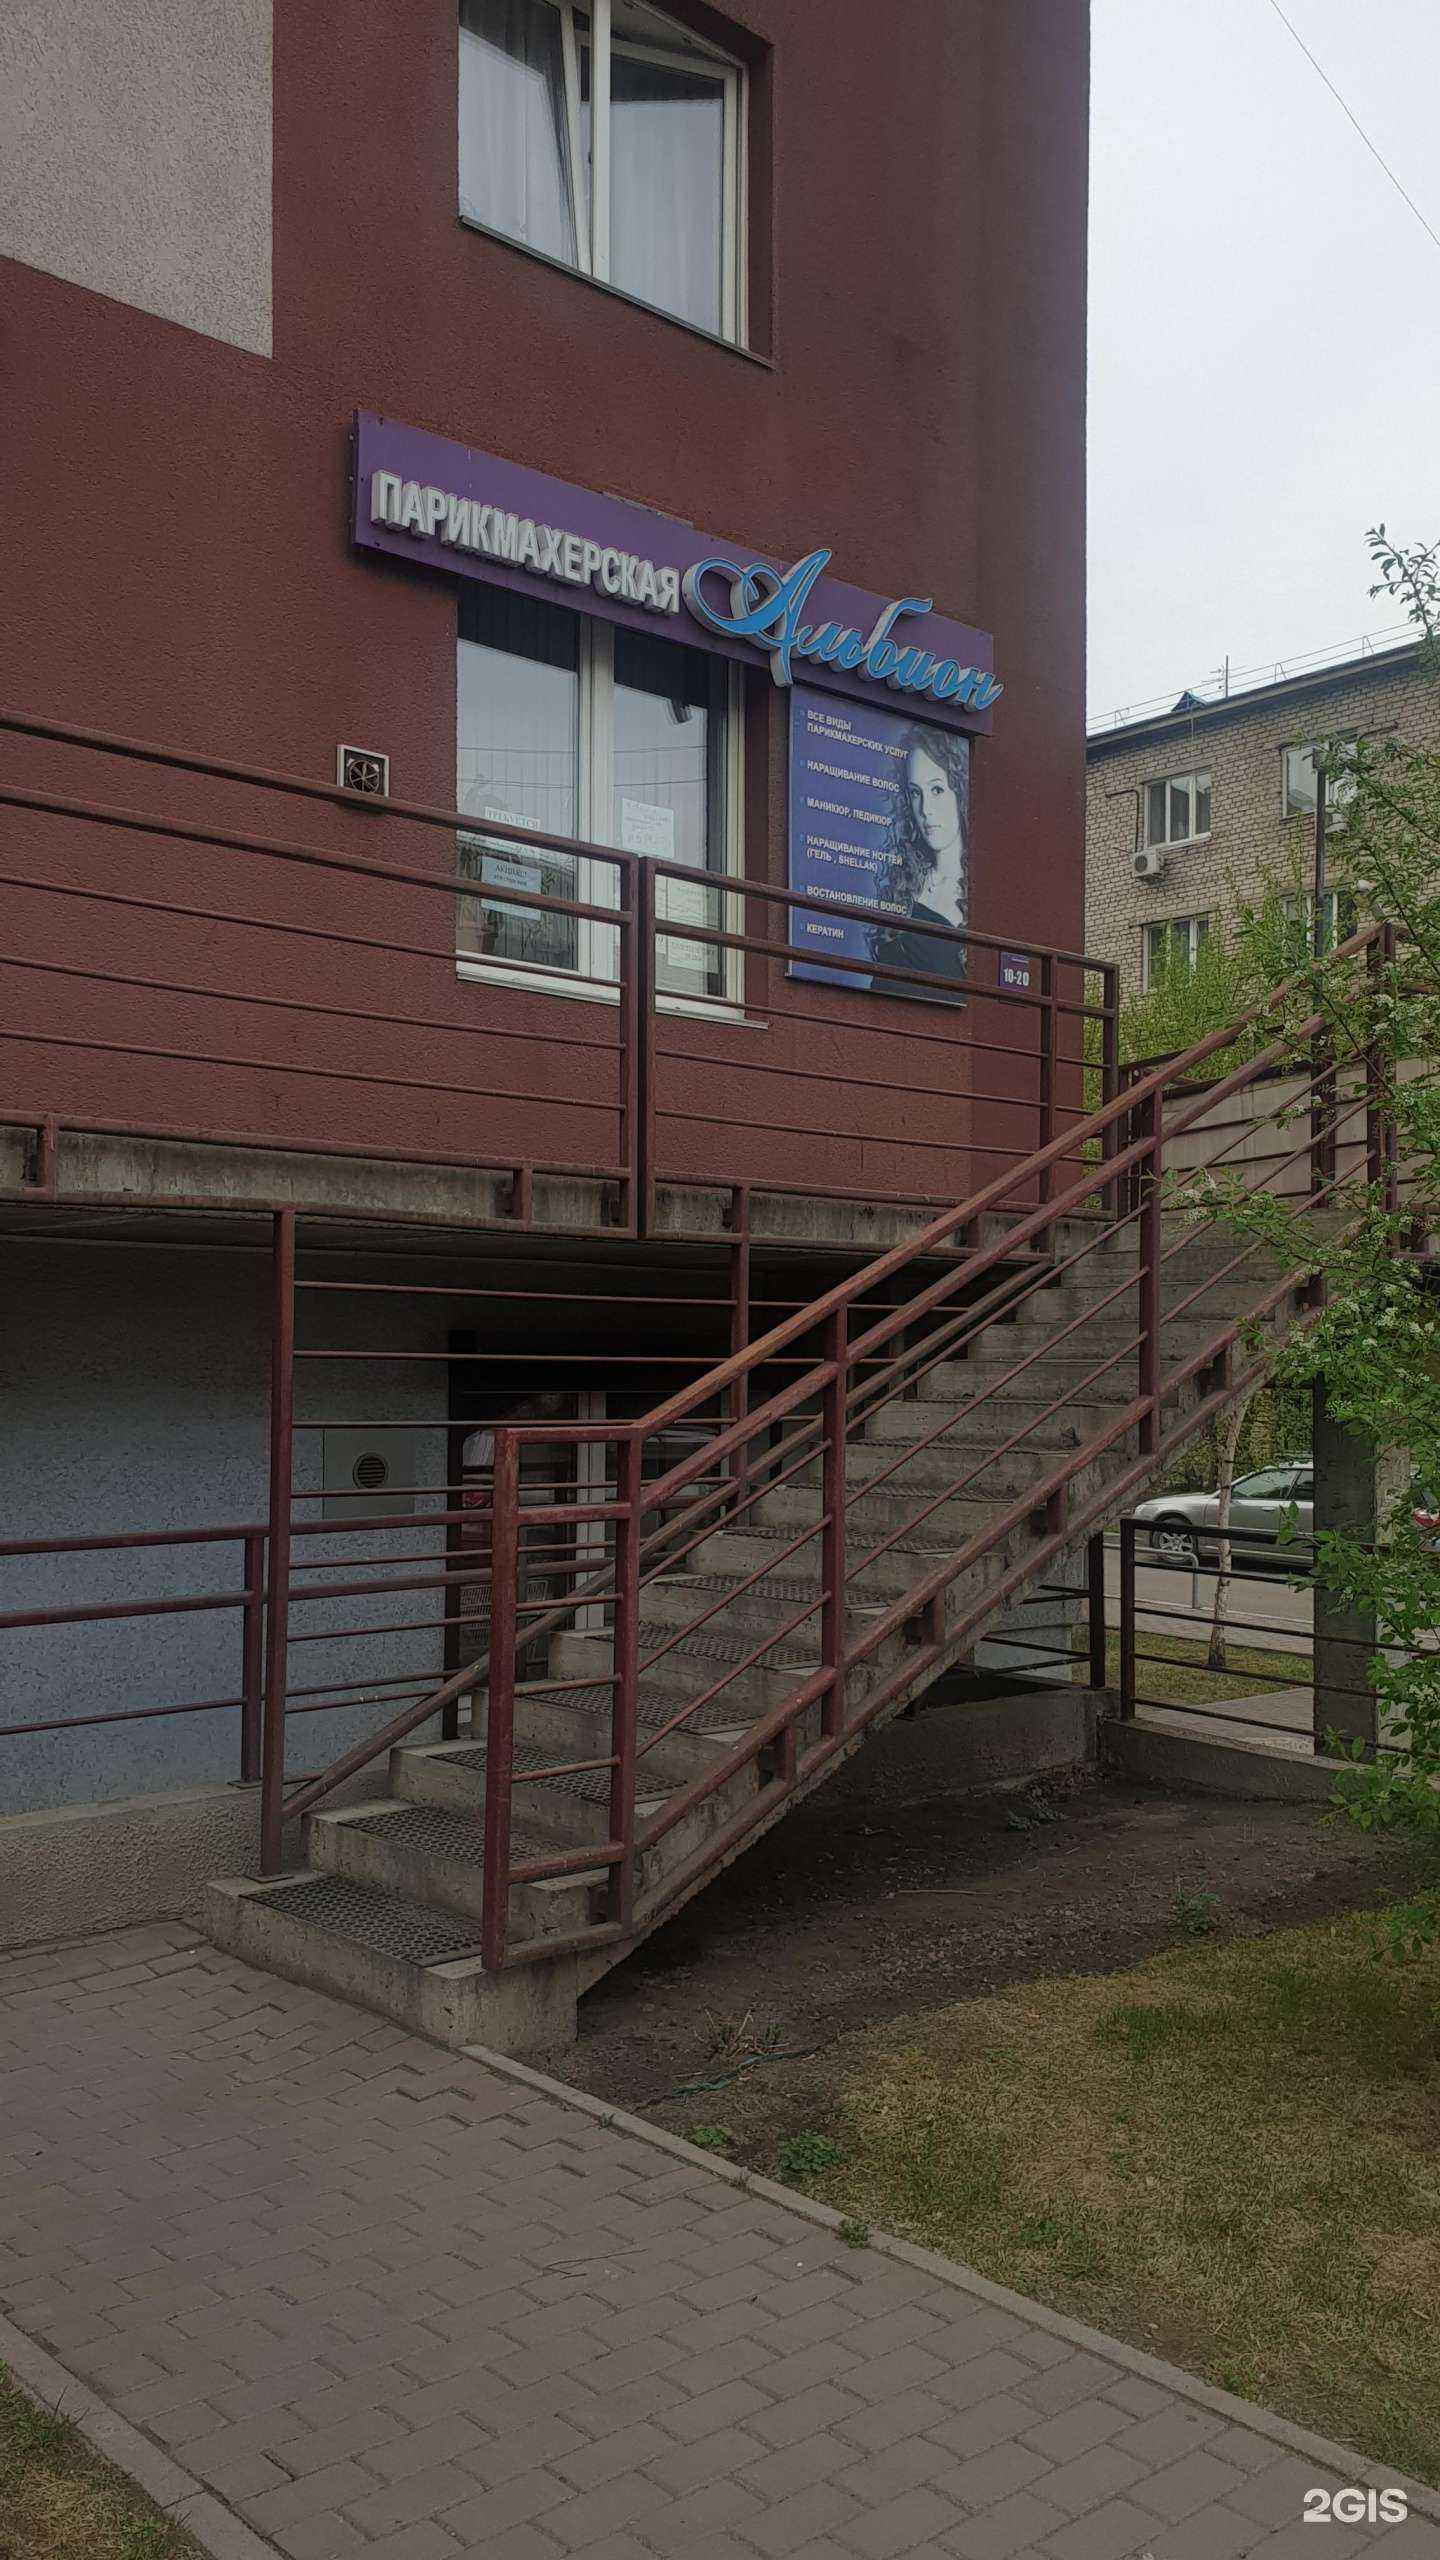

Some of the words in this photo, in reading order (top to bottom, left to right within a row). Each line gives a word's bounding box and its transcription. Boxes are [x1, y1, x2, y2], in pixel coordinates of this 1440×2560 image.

[371, 469, 680, 616] ПАРИКМАХЕРСКАЯ
[807, 710, 825, 723] ВСЕ
[826, 715, 852, 731] ВИДЫ
[807, 722, 883, 753] ПАРИКМАХЕРСКИХ
[884, 744, 909, 760] УСЛУГ
[807, 760, 871, 785] НАРАЩИВАНИЕ
[872, 778, 900, 793] ВОЛОС
[807, 796, 852, 818] МАНИКЮР,
[853, 808, 893, 826] ПЕДИКЮР
[807, 835, 871, 859] НАРАЩИВАНИЕ
[872, 850, 903, 866] НОГТЕЙ
[807, 885, 879, 909] ВОСТАНОВЛЕНИЕ
[880, 901, 907, 915] ВОЛОС
[807, 922, 845, 939] КЕРАТИН
